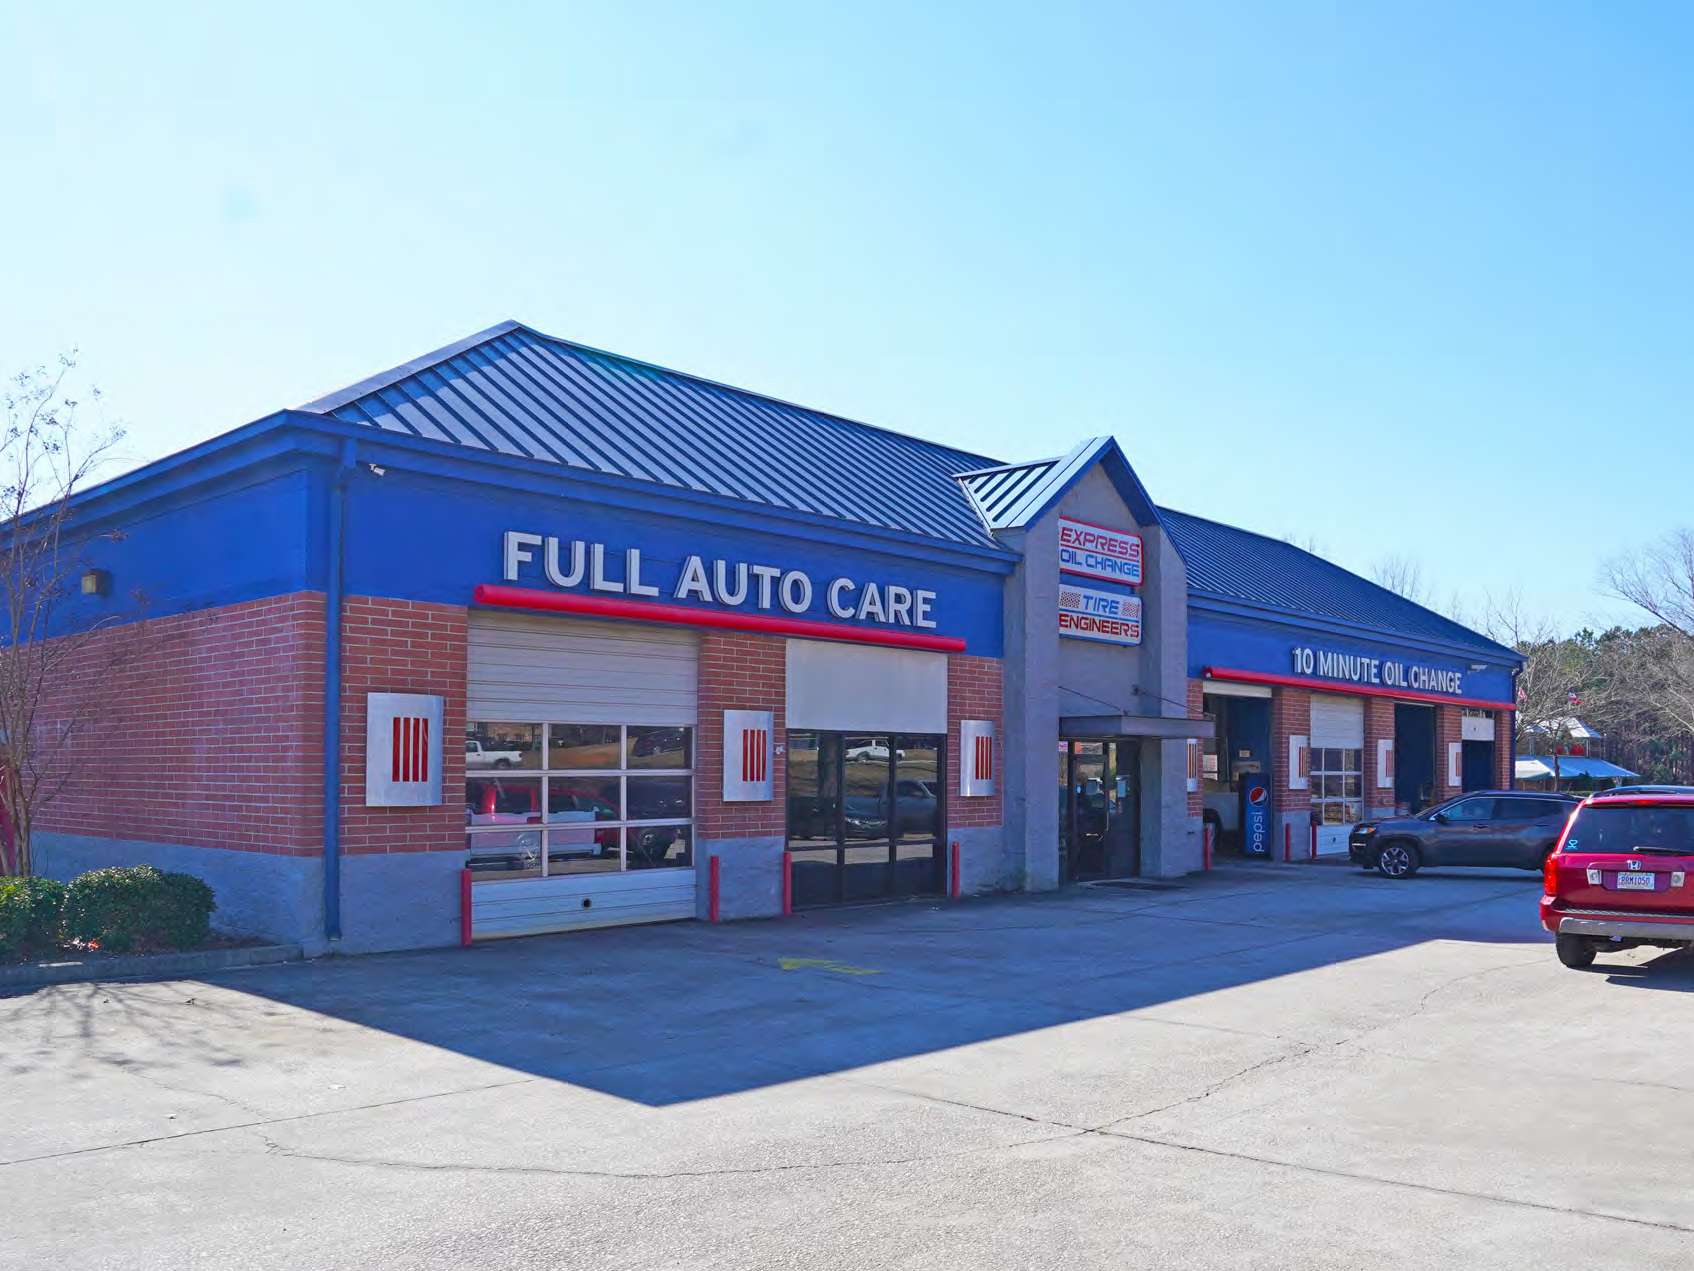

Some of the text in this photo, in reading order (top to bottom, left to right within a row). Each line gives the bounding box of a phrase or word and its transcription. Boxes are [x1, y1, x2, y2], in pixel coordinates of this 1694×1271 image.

[1060, 527, 1140, 558] EXPRESS
[1060, 548, 1140, 577] OIL CHANGE
[504, 531, 937, 629] FULL AUTO CARE
[1083, 594, 1120, 615] TIRE
[1059, 613, 1140, 638] ENGINEERS
[1292, 647, 1463, 694] 10 MINUTE OIL CHANGE
[1251, 811, 1265, 852] pepsi
